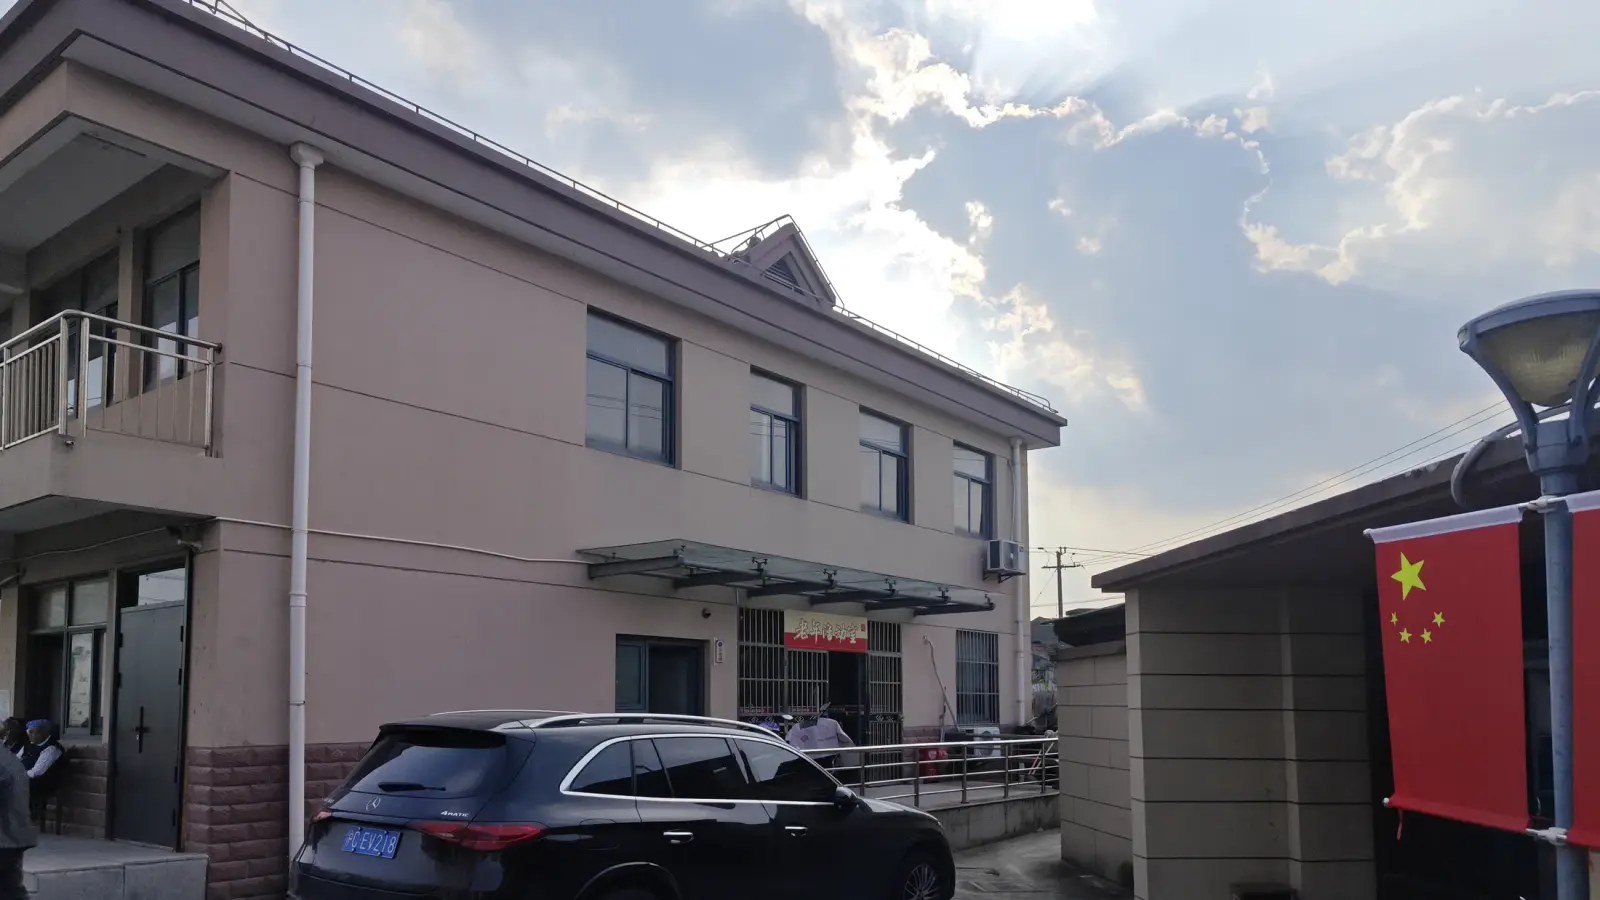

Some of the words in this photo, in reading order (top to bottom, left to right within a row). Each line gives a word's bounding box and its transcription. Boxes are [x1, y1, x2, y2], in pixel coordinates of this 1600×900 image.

[793, 617, 858, 644] 老年活动室
[440, 810, 470, 818] 4MATIC
